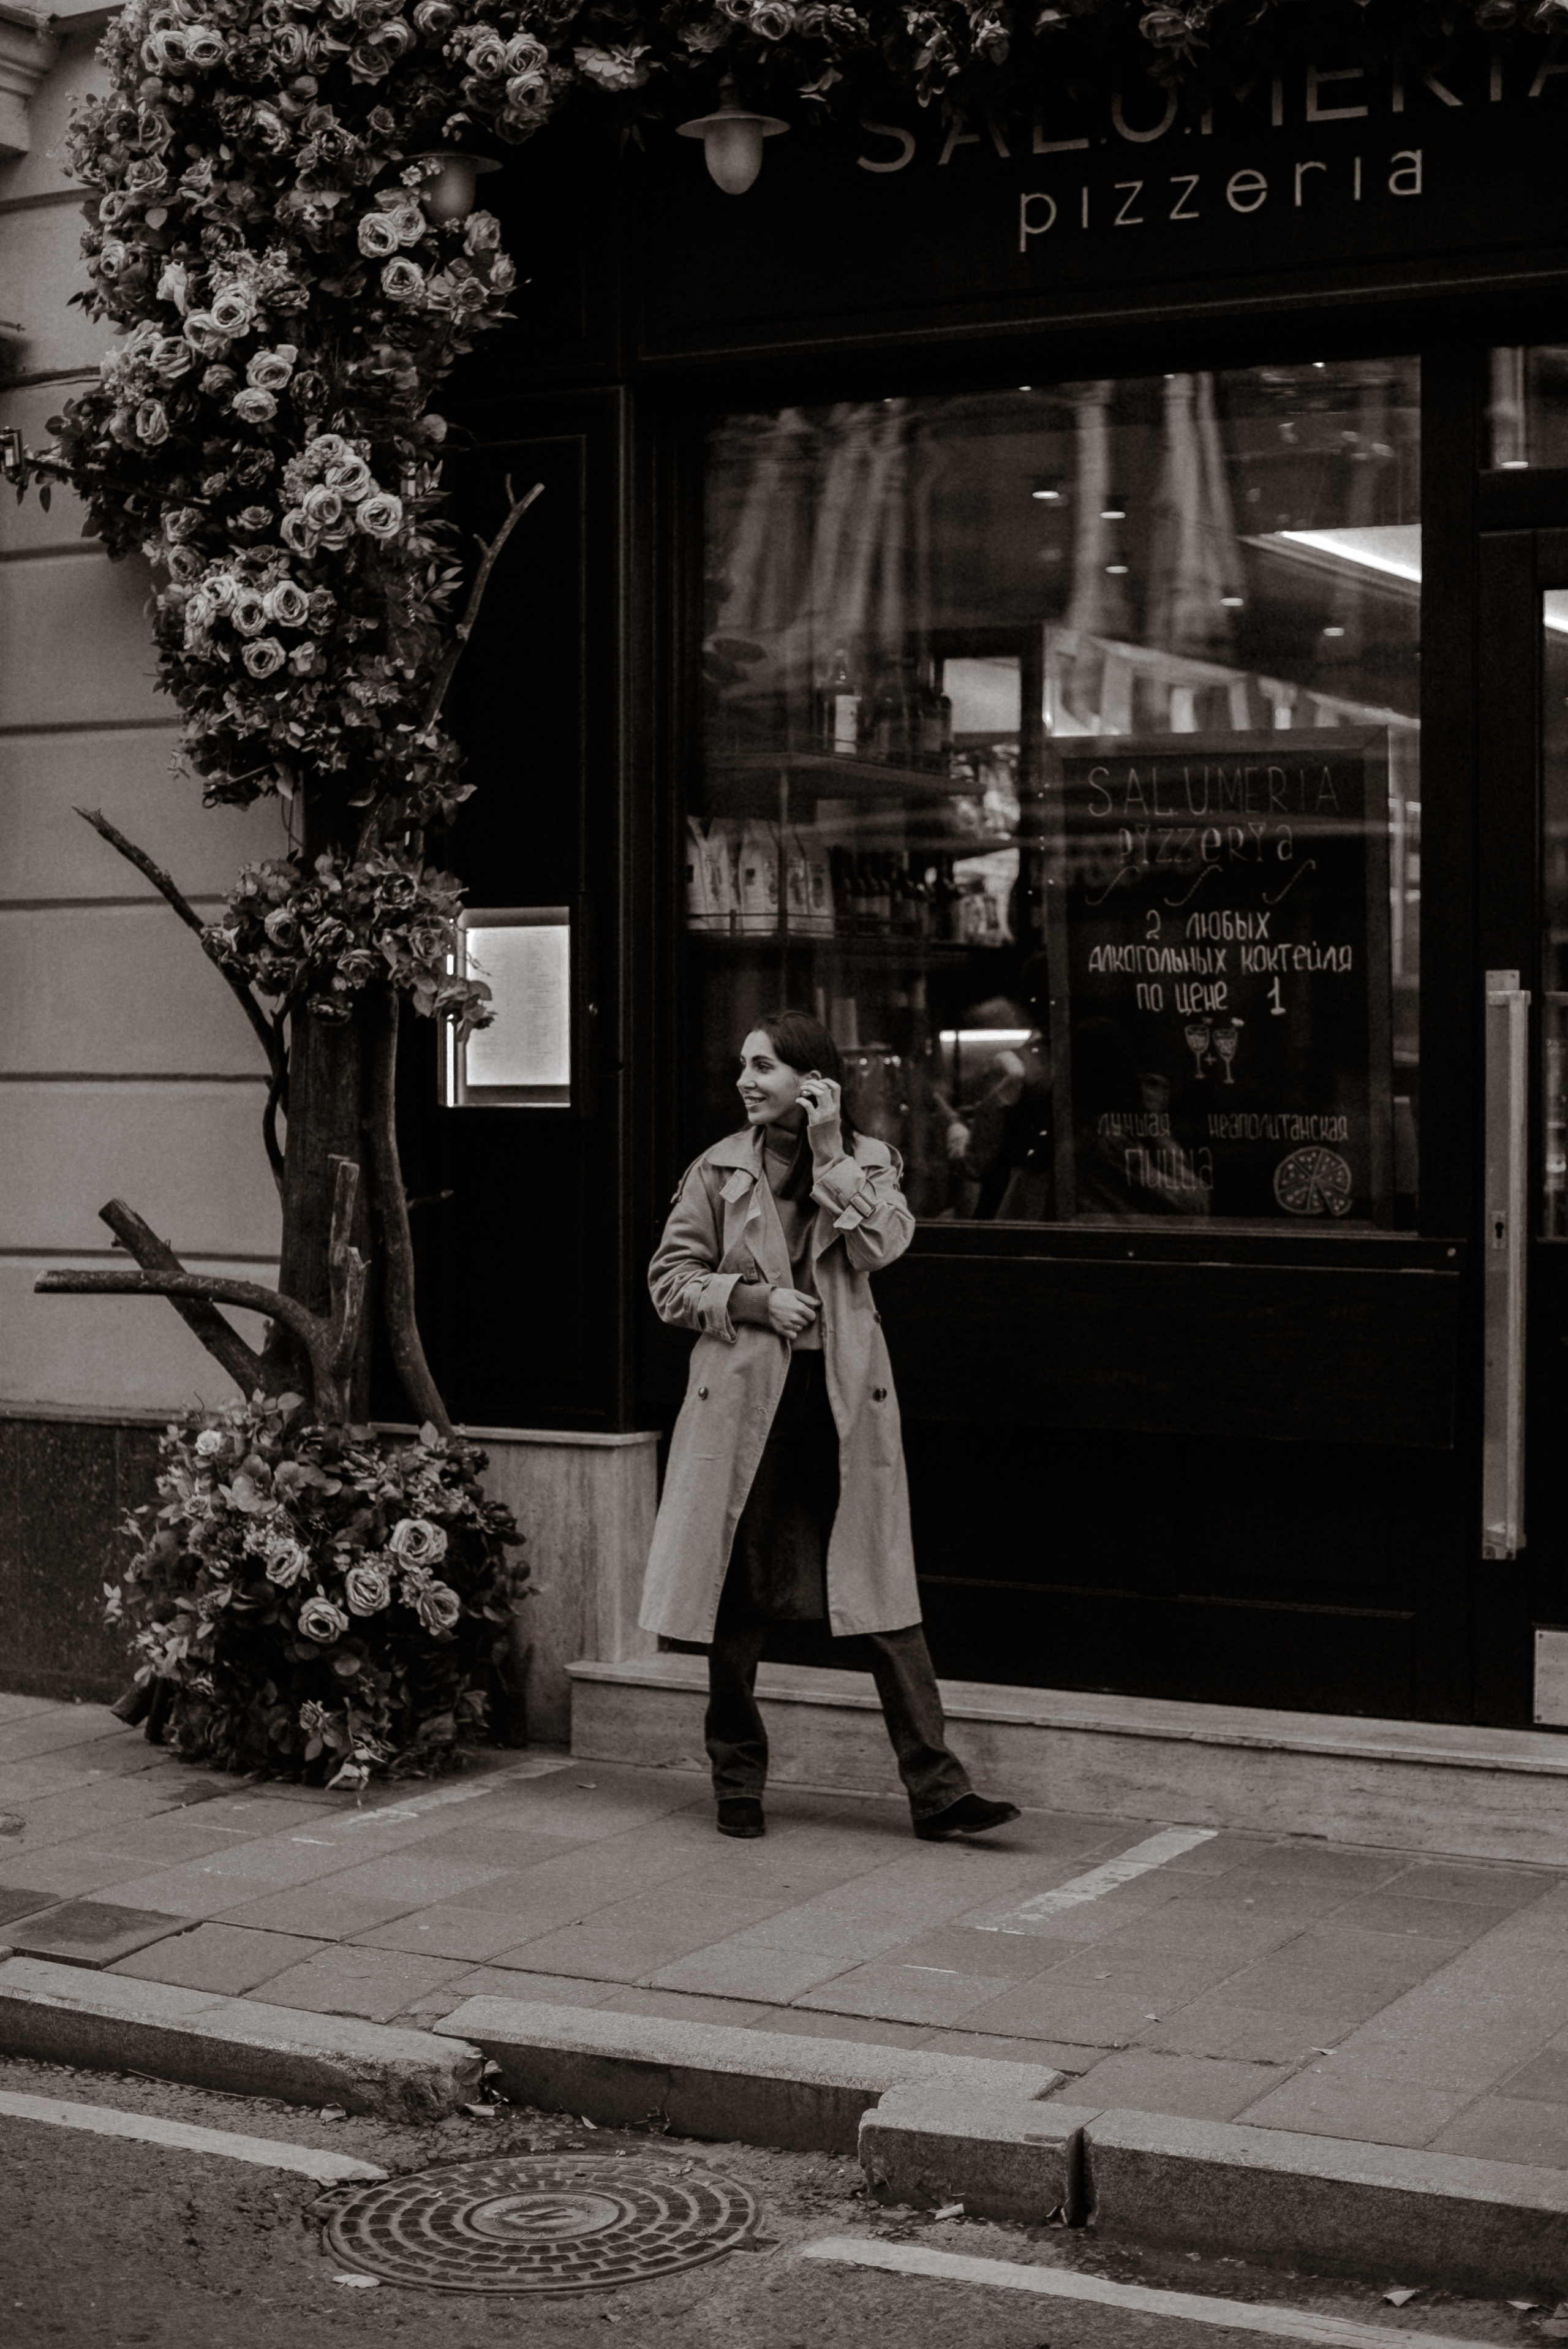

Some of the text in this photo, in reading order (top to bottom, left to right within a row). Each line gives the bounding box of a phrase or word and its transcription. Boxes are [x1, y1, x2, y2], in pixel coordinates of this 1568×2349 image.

[1019, 148, 1423, 254] pizzeria
[1145, 909, 1162, 940] 2
[1266, 976, 1286, 1016] 1
